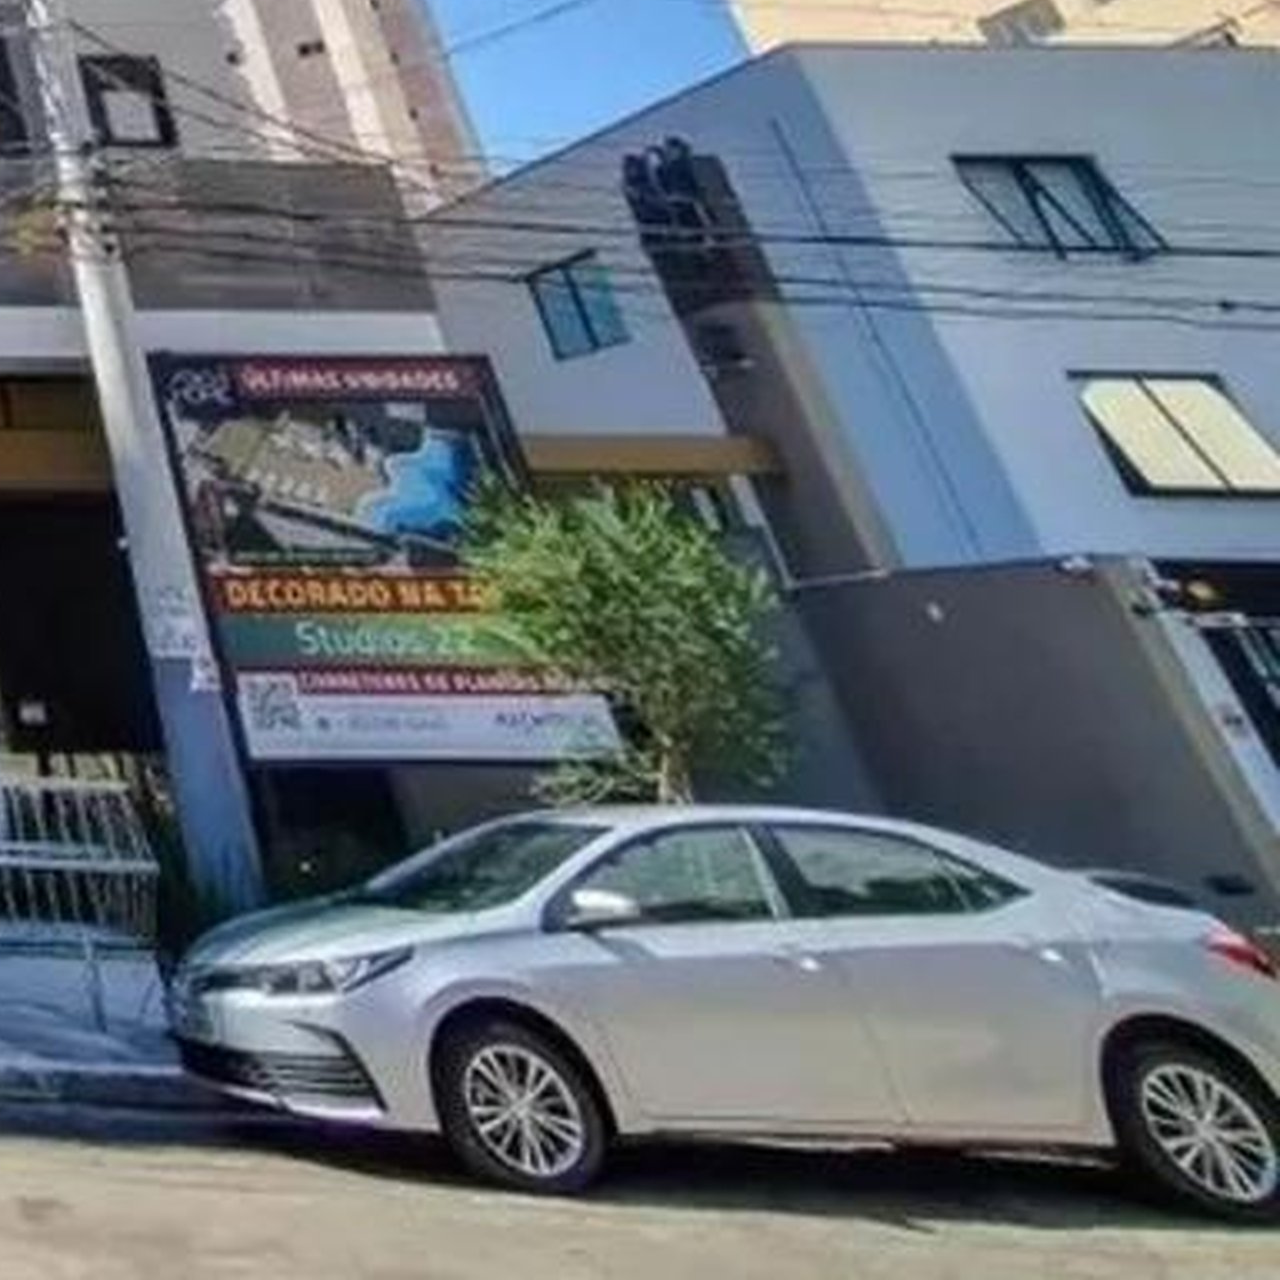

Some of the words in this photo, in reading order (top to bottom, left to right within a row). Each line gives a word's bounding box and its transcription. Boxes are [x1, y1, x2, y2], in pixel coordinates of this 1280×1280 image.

[224, 579, 390, 607] DECORADO
[398, 580, 444, 606] NA
[295, 621, 425, 656] Studios
